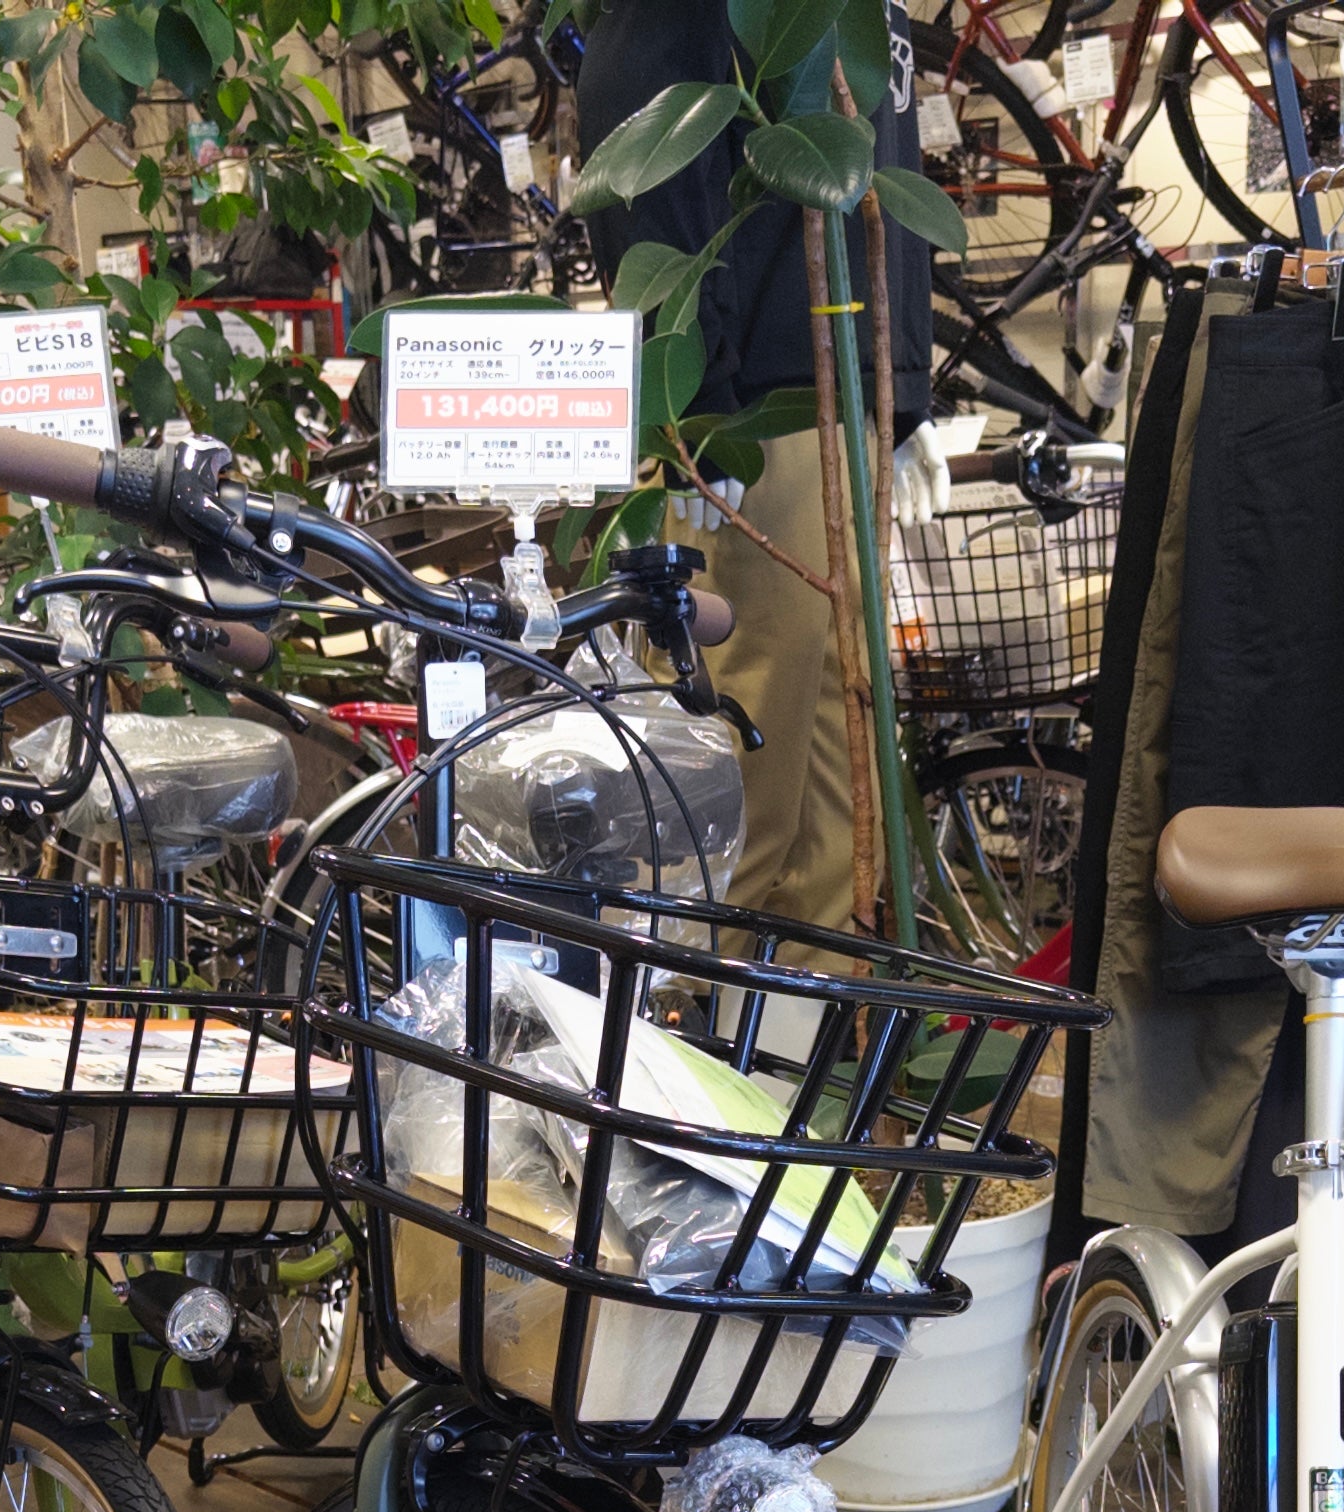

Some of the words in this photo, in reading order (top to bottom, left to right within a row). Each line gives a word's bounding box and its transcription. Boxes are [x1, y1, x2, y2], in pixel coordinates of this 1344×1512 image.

[16, 333, 94, 353] ビビS18
[396, 336, 503, 352] Panasonic
[528, 338, 626, 357] グリッター
[400, 359, 454, 368] タイヤサイズ
[421, 394, 558, 421] 131,400円
